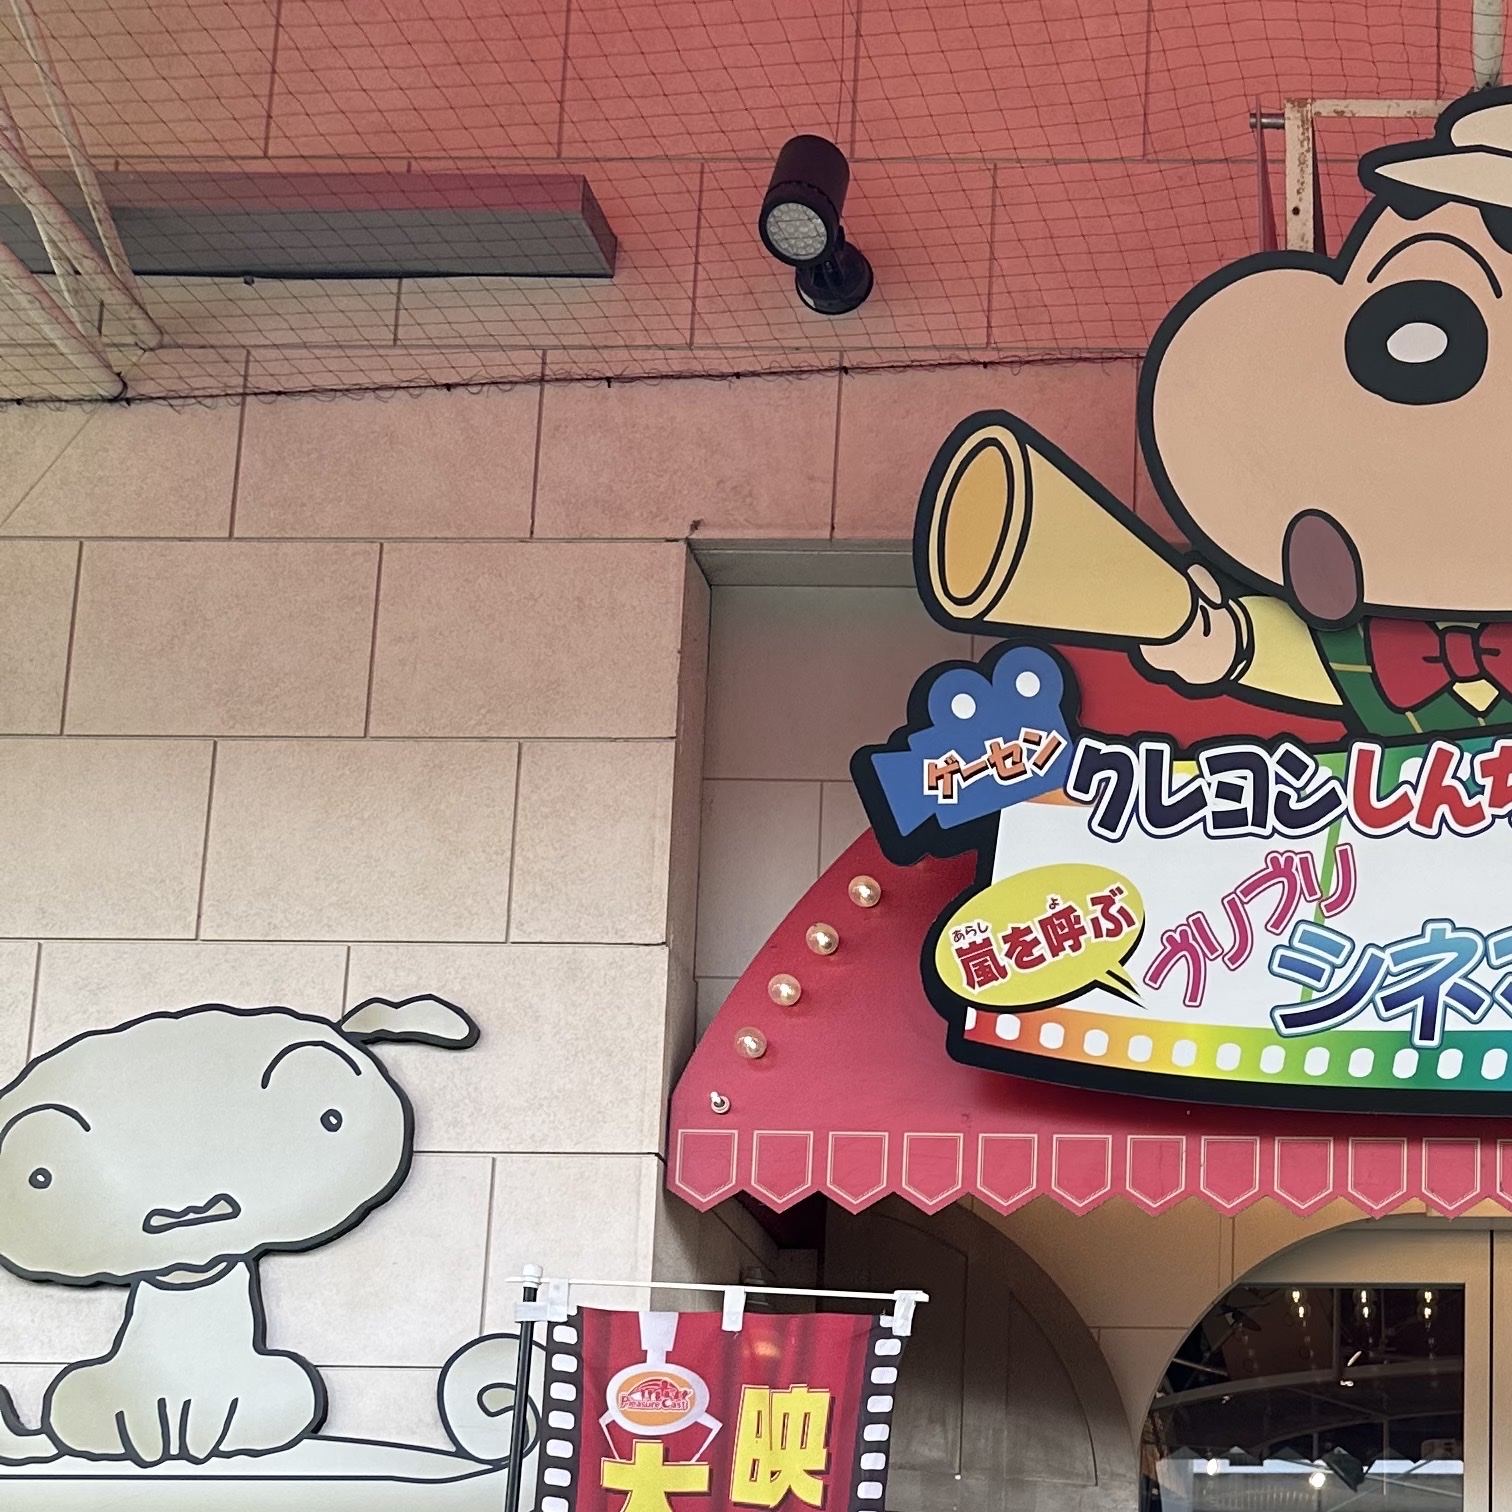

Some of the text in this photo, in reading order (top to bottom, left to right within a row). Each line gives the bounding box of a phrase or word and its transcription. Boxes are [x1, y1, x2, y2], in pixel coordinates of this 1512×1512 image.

[926, 730, 1066, 801] ゲーセン
[951, 921, 990, 943] あらし
[954, 886, 1137, 990] 嵐を呼ぶ
[1144, 843, 1359, 1008] ブリブリ
